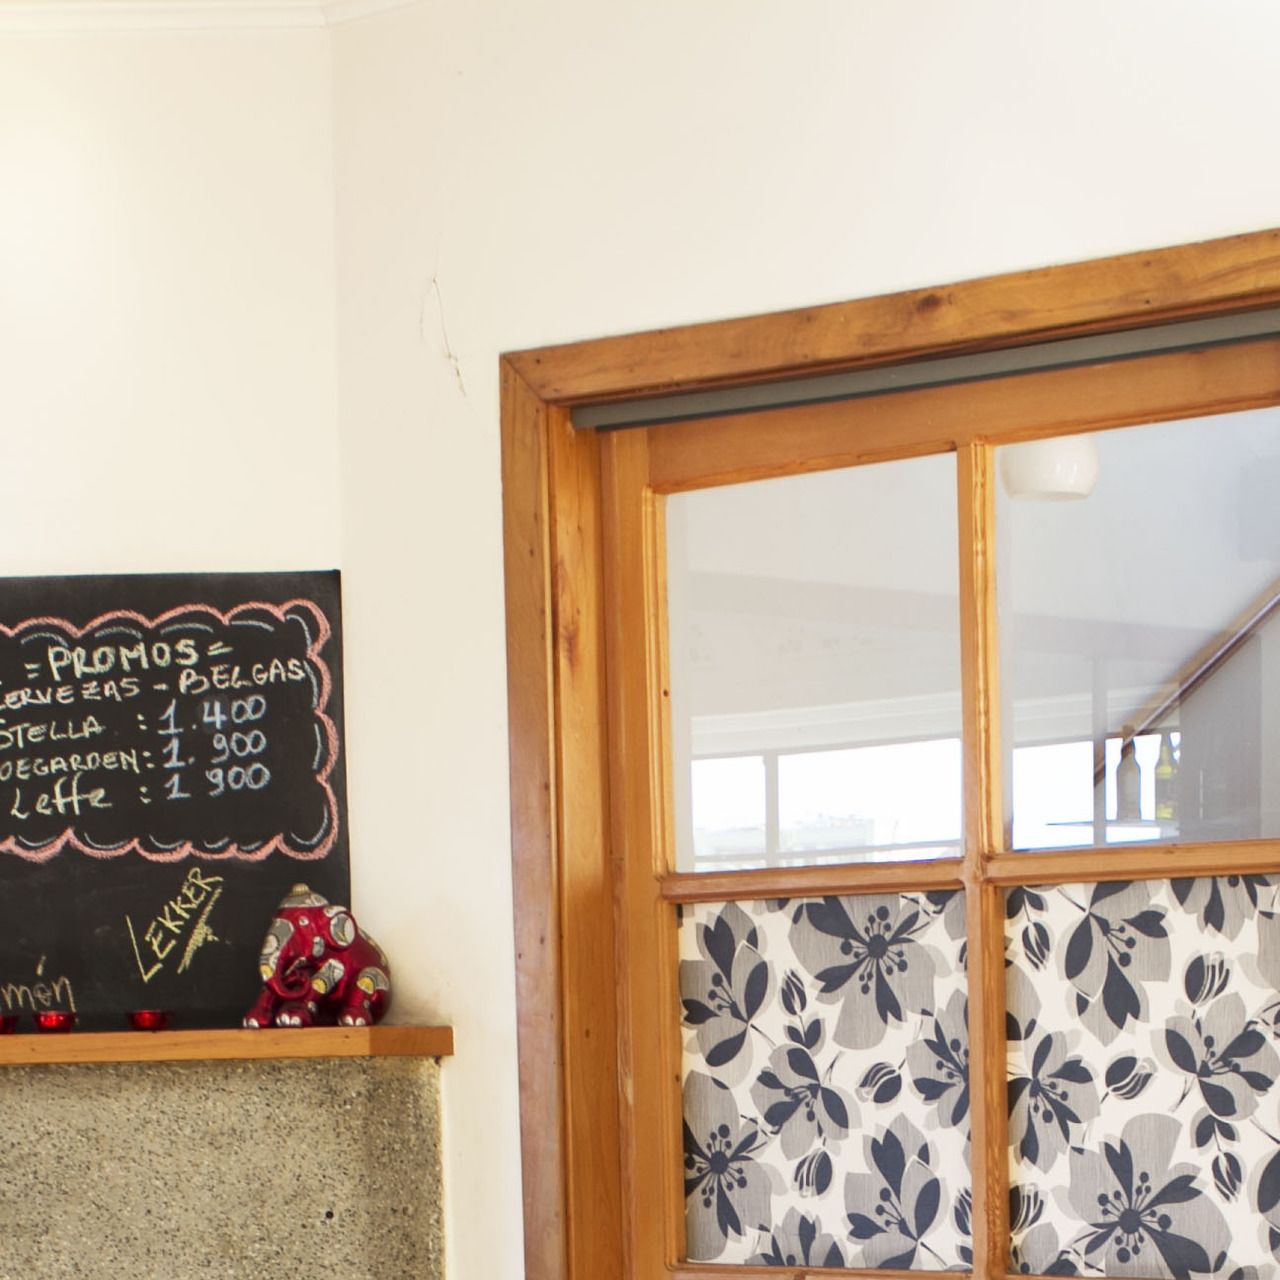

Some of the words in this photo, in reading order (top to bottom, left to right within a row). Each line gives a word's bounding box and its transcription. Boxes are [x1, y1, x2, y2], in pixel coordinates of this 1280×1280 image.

[48, 640, 200, 681] PROMOS
[179, 658, 308, 694] BELGAS
[125, 867, 223, 982] LEKKER
